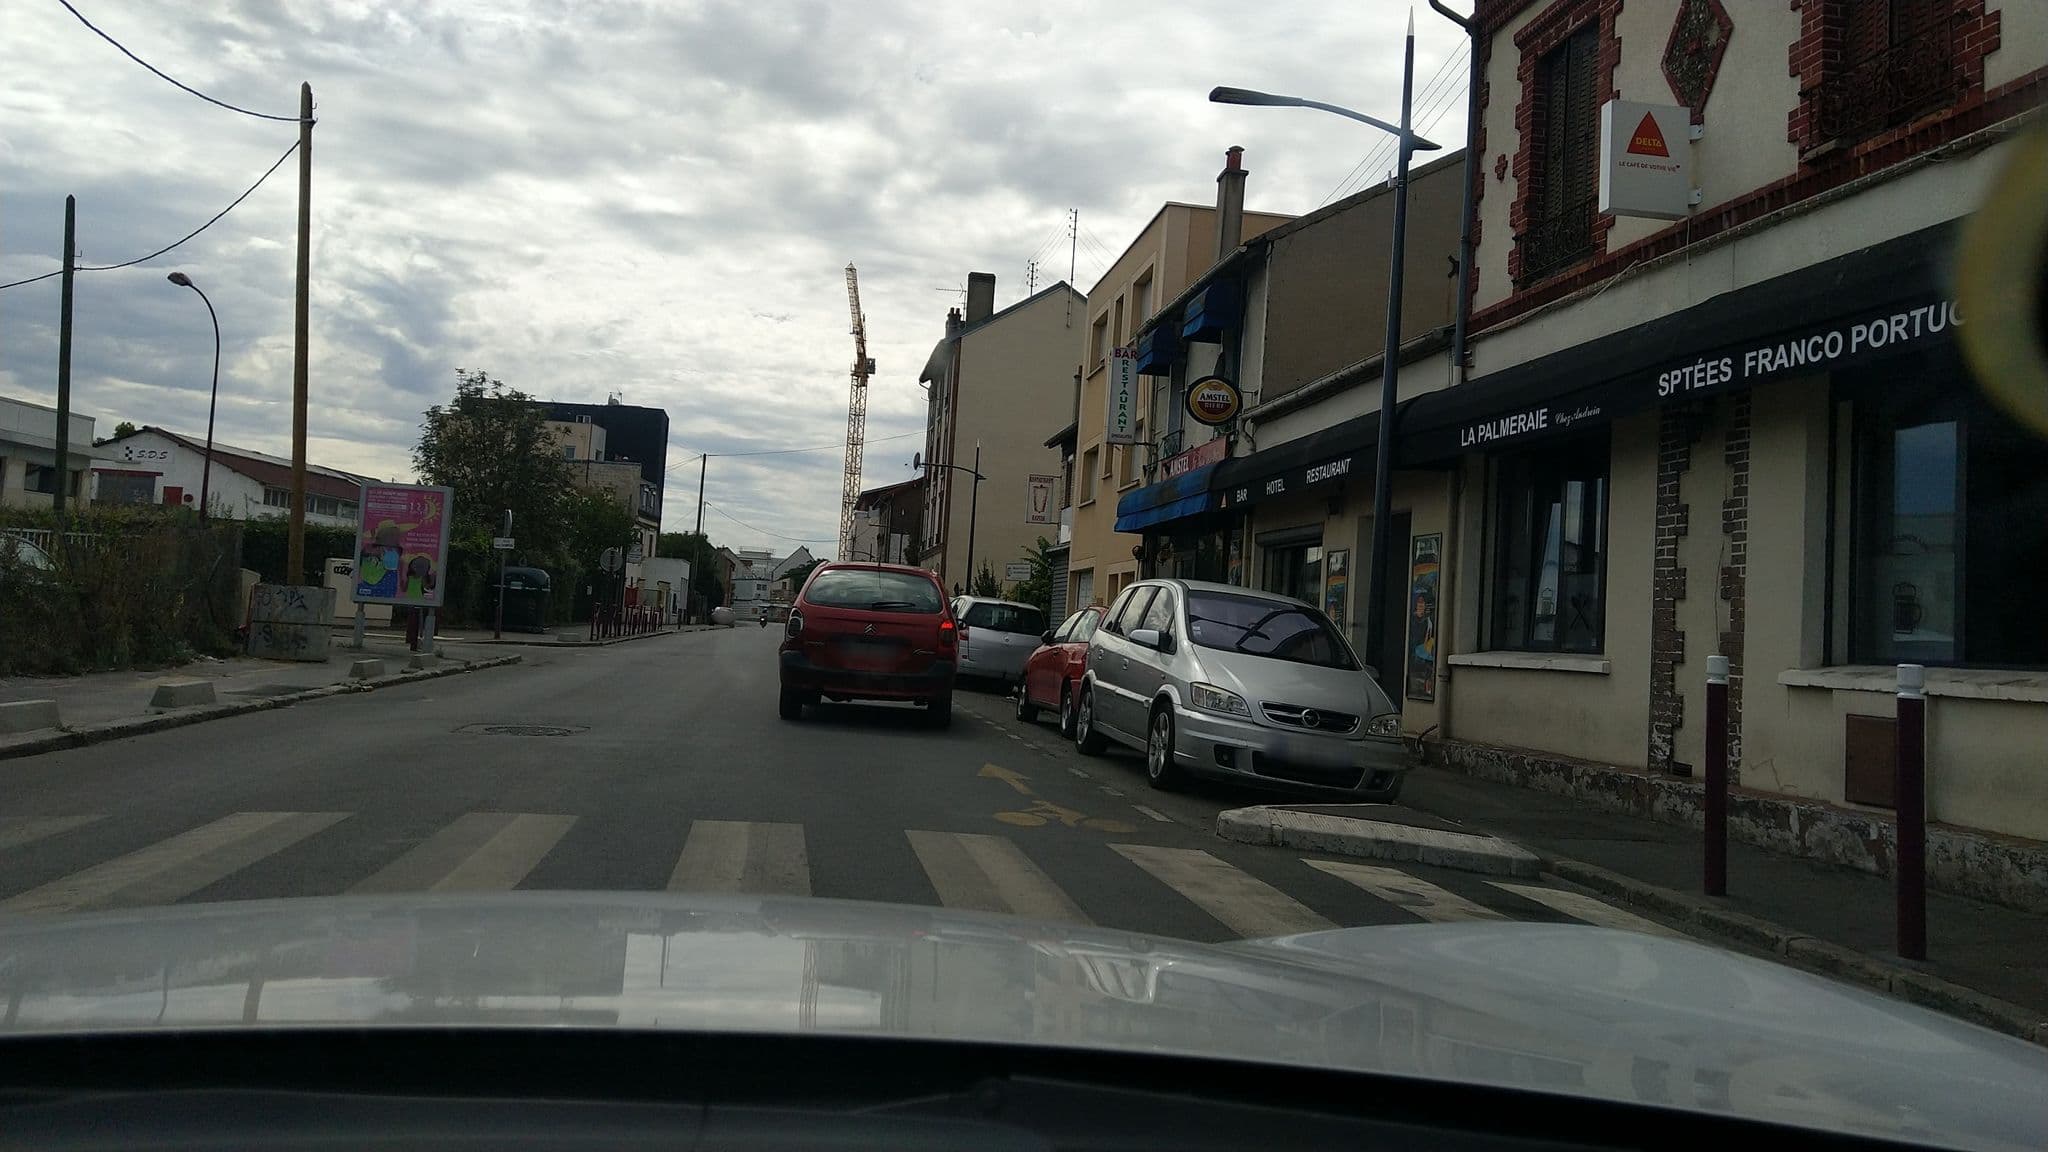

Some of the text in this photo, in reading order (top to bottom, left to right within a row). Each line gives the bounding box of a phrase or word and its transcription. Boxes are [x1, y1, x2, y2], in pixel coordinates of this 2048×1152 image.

[1635, 137, 1662, 147] DELTA
[1114, 348, 1138, 360] BAR
[1657, 357, 1732, 397] SPTÉES
[1743, 330, 1843, 377] FRANCO
[1117, 359, 1129, 433] RESTAURANT
[1200, 392, 1231, 402] AMSTEL
[1461, 426, 1476, 447] LA
[1478, 407, 1548, 443] PALMERAIE
[1236, 457, 1352, 503] BAR HOTEL RESTAURANT
